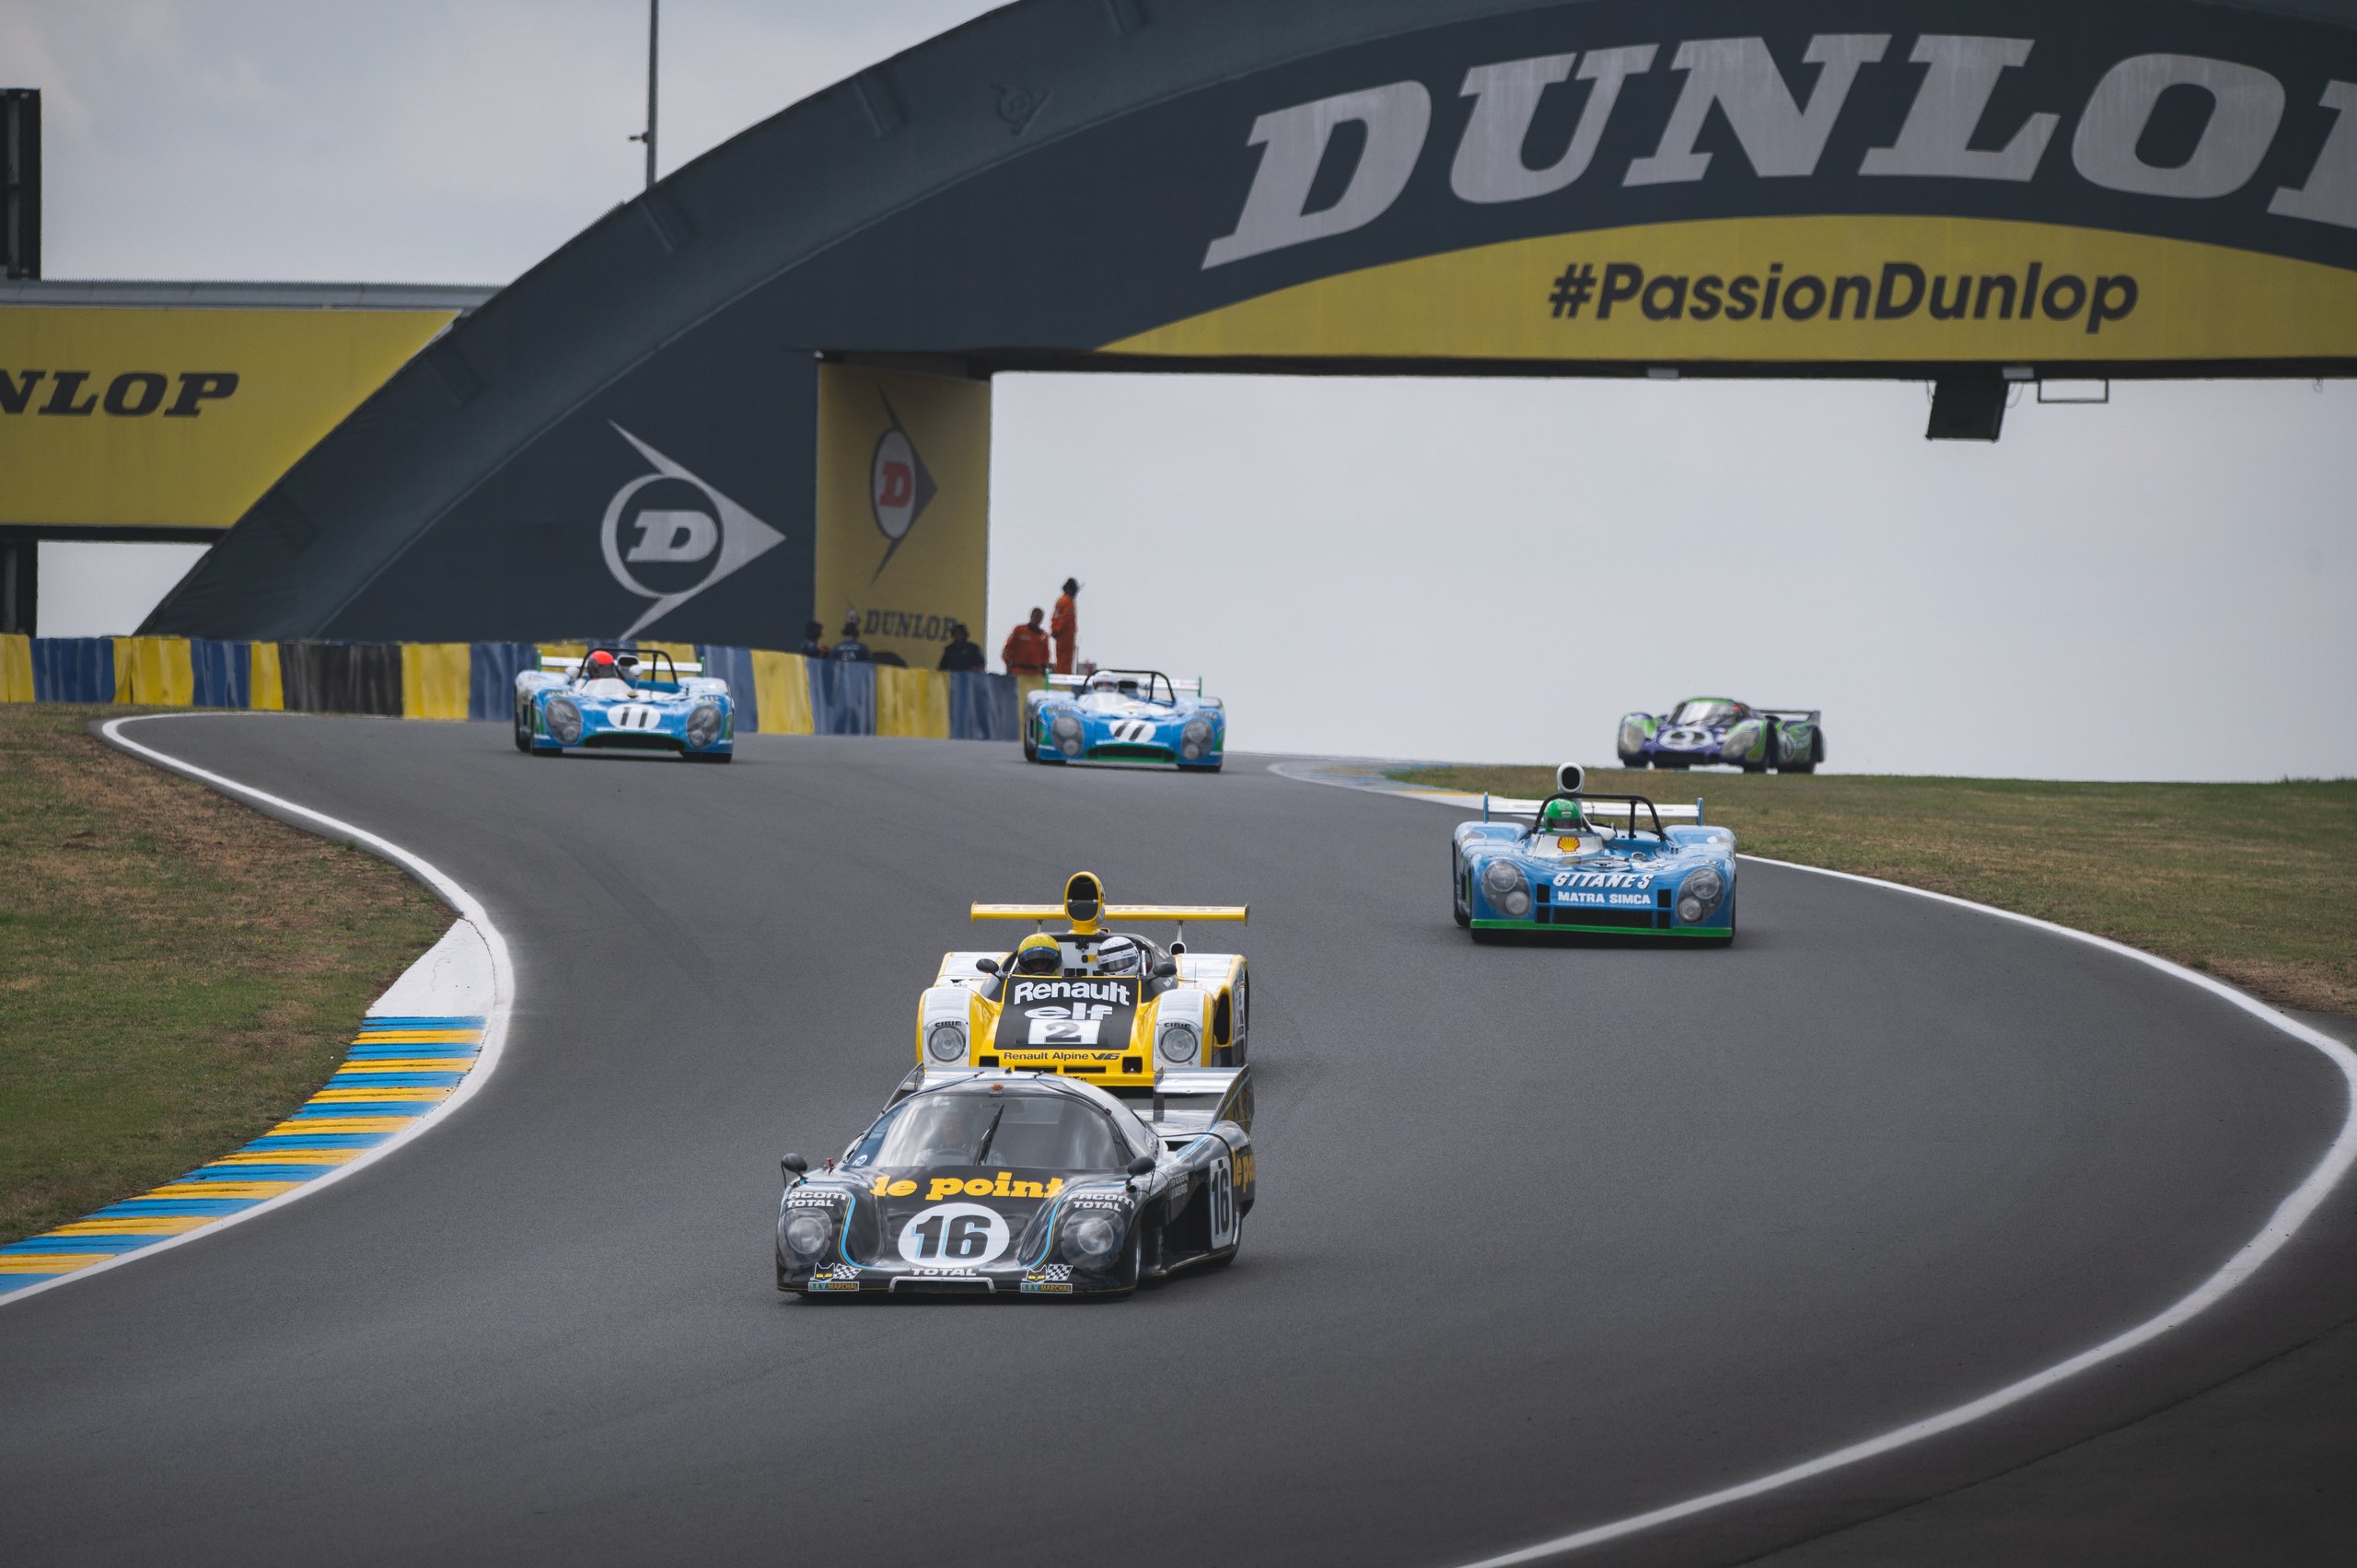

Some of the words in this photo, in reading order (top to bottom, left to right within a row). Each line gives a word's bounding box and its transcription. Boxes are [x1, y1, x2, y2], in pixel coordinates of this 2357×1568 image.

[1548, 261, 2140, 335] #PassionDunlop
[878, 461, 913, 507] D
[626, 509, 718, 563] D
[620, 706, 649, 728] 11
[1113, 721, 1146, 741] 11
[1552, 871, 1655, 889] GITANES
[1558, 891, 1606, 903] MATRA
[1609, 893, 1652, 905] SIMCA
[1014, 981, 1131, 1005] Renault
[1024, 1002, 1113, 1020] elf
[1045, 1021, 1082, 1043] 2
[1004, 1051, 1051, 1060] Renault
[1052, 1051, 1088, 1062] Alpine
[784, 1191, 847, 1201] ACOM
[869, 1175, 918, 1197] le
[925, 1171, 1064, 1201] point
[786, 1199, 834, 1208] TOTAL
[1074, 1201, 1121, 1212] TOTAL
[1211, 1167, 1230, 1236] 16
[911, 1214, 992, 1260] 16
[912, 1268, 976, 1276] TOTAL
